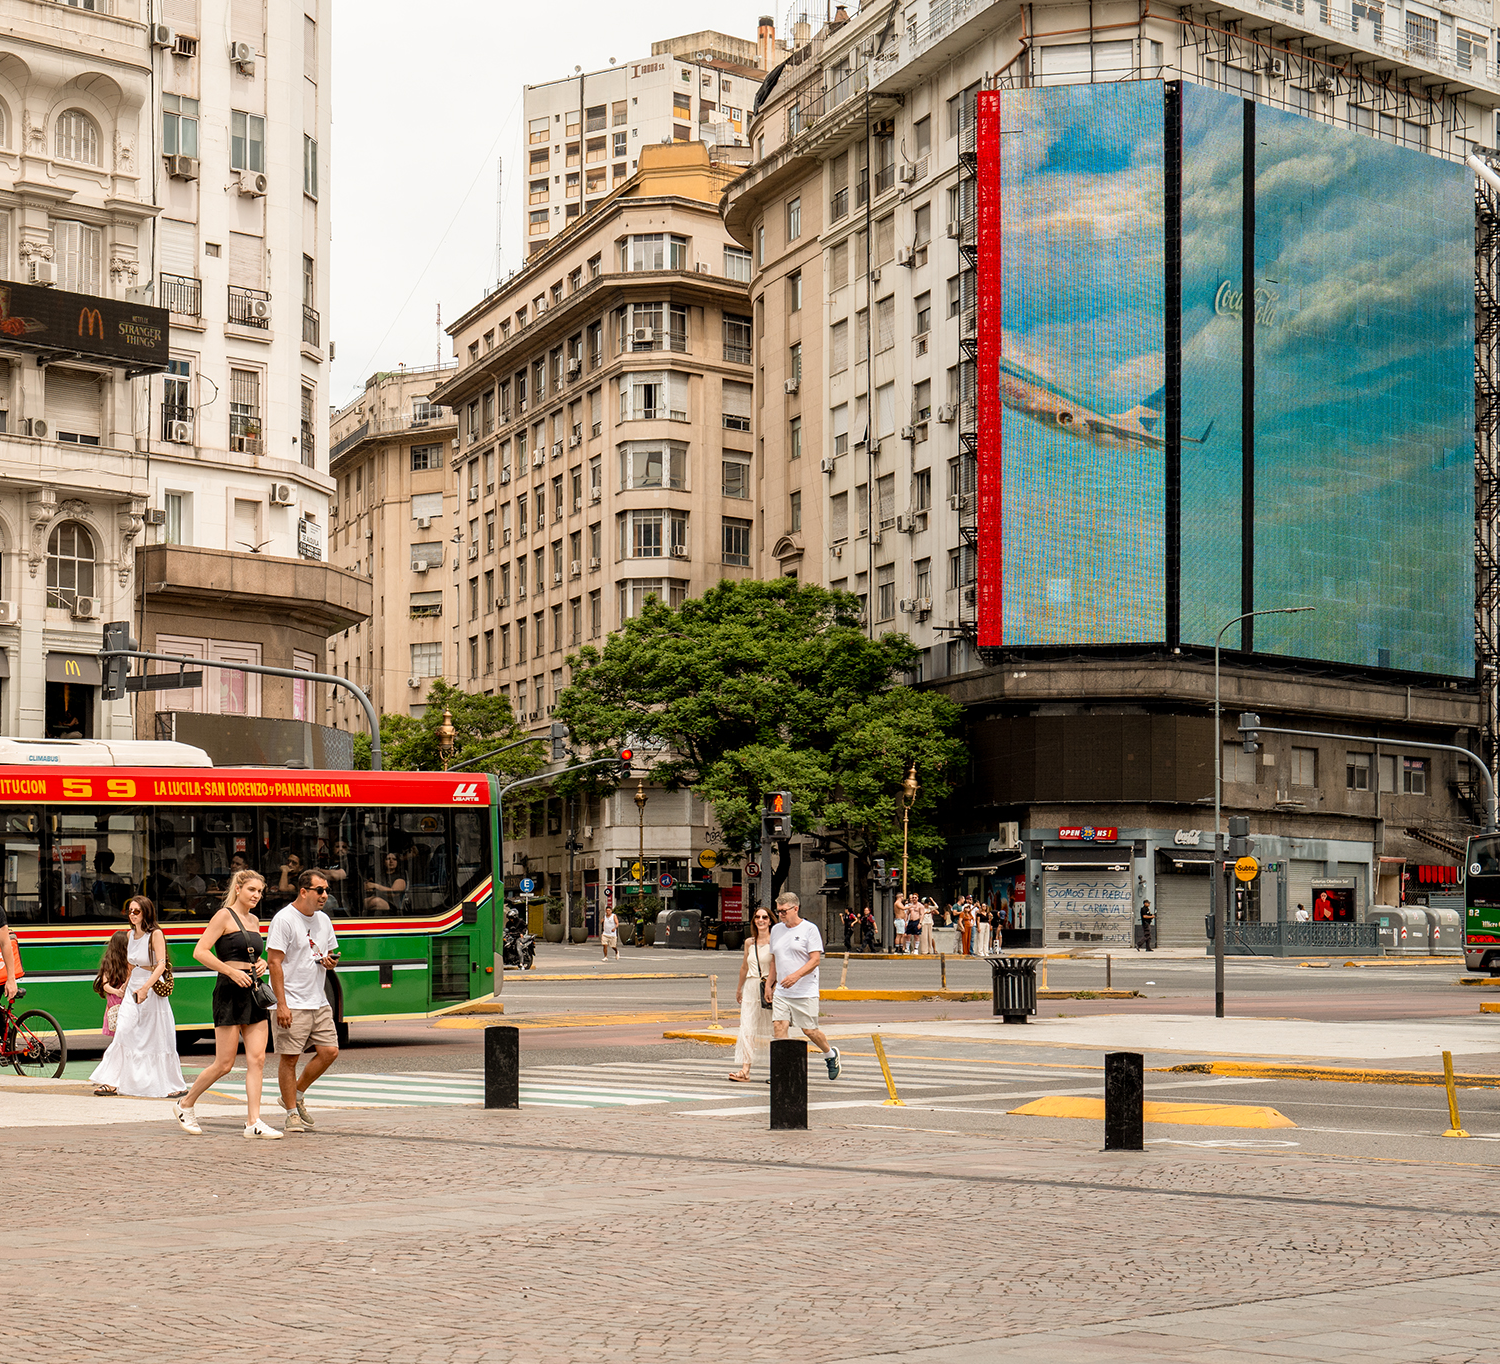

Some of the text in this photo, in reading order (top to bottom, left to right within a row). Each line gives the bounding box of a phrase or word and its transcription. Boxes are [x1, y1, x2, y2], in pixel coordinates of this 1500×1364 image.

[118, 322, 161, 341] STRANGER
[126, 335, 155, 348] THINGS
[28, 755, 59, 763] CLIMABUS
[154, 781, 167, 796] LA
[227, 782, 268, 797] LORENZO
[275, 783, 351, 798] PANAMERICANA
[523, 879, 530, 888] E
[1066, 901, 1079, 912] EL
[1082, 903, 1129, 914] CARNAVAL
